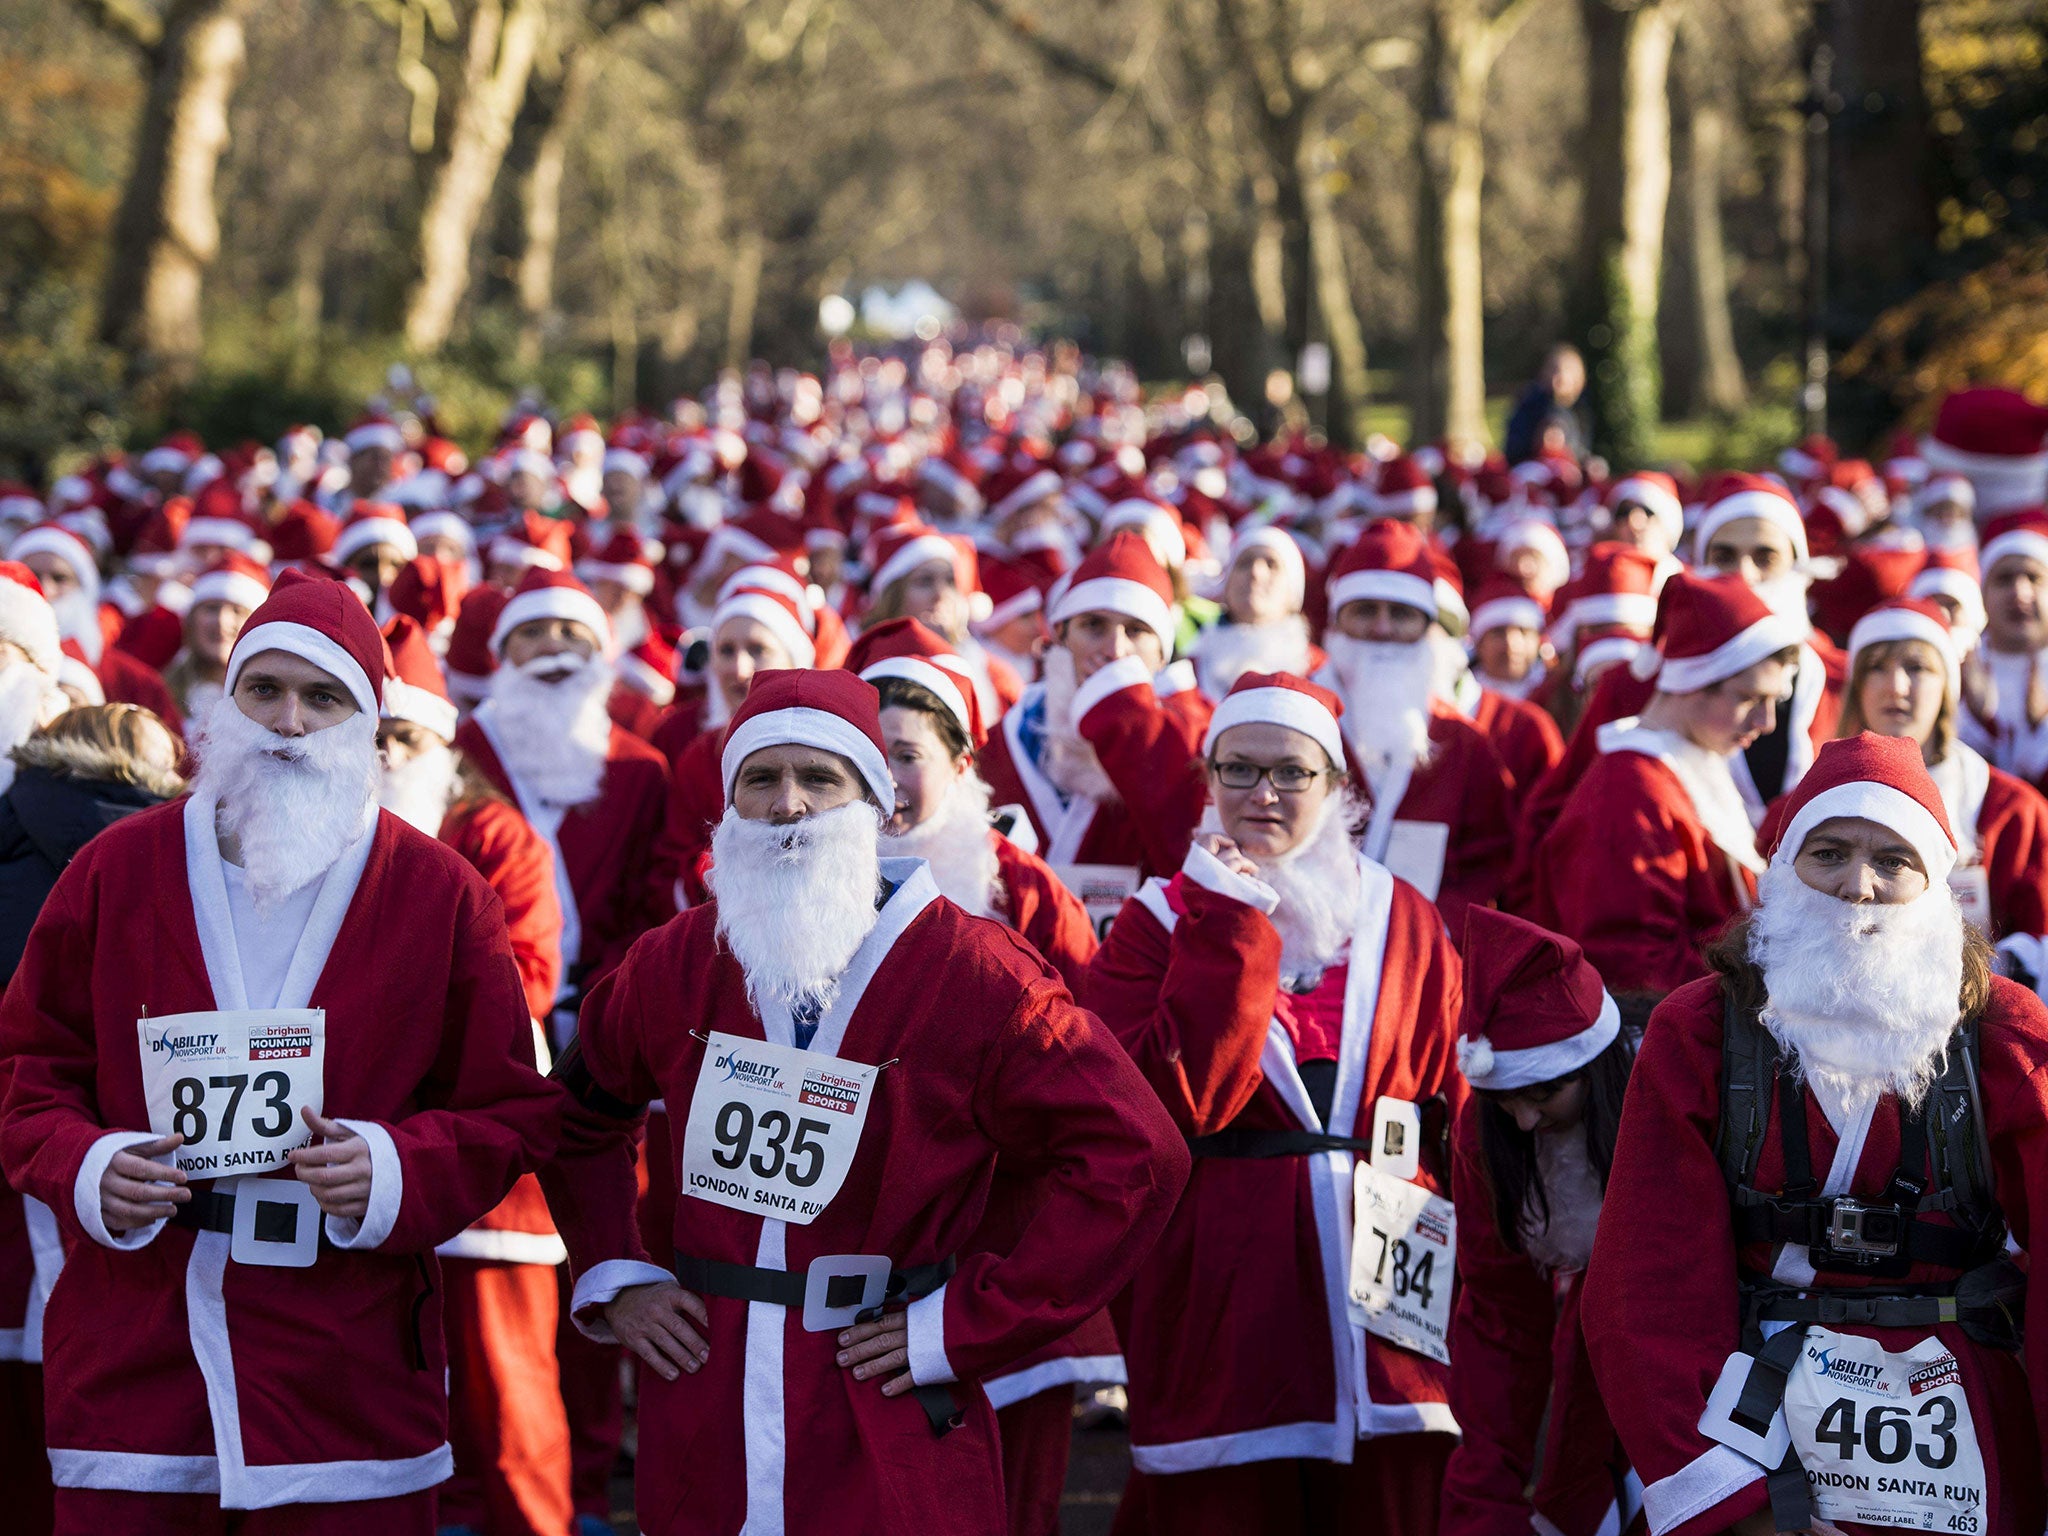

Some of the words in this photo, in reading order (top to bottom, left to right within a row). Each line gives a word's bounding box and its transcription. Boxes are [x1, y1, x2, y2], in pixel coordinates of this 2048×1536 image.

[174, 1047, 214, 1057] NOWSPORT
[215, 1046, 227, 1055] UK
[250, 1037, 310, 1049] MOUNTAIN
[258, 1048, 302, 1059] SPORTS
[733, 1072, 773, 1087] NOWSPORT
[773, 1080, 785, 1090] UK
[803, 1081, 858, 1102] MOUNTAIN
[172, 1071, 293, 1146] 873
[807, 1094, 848, 1111] SPORTS
[712, 1101, 831, 1187] 935
[224, 1150, 276, 1167] SANTA
[690, 1173, 749, 1200] LONDON
[753, 1190, 796, 1211] SANTA
[1372, 1226, 1435, 1309] 784
[1827, 1370, 1876, 1388] NOWSPORT
[1876, 1381, 1890, 1391] UK
[1910, 1361, 1959, 1384] MOUNTA
[1815, 1395, 1958, 1470] 463
[1807, 1469, 1870, 1491] ONDON
[1877, 1477, 1937, 1498] SANTA
[1944, 1485, 1980, 1503] RUN
[1857, 1512, 1891, 1522] BAGGAGE
[1894, 1516, 1915, 1525] LABEL
[1947, 1514, 1978, 1533] 463
